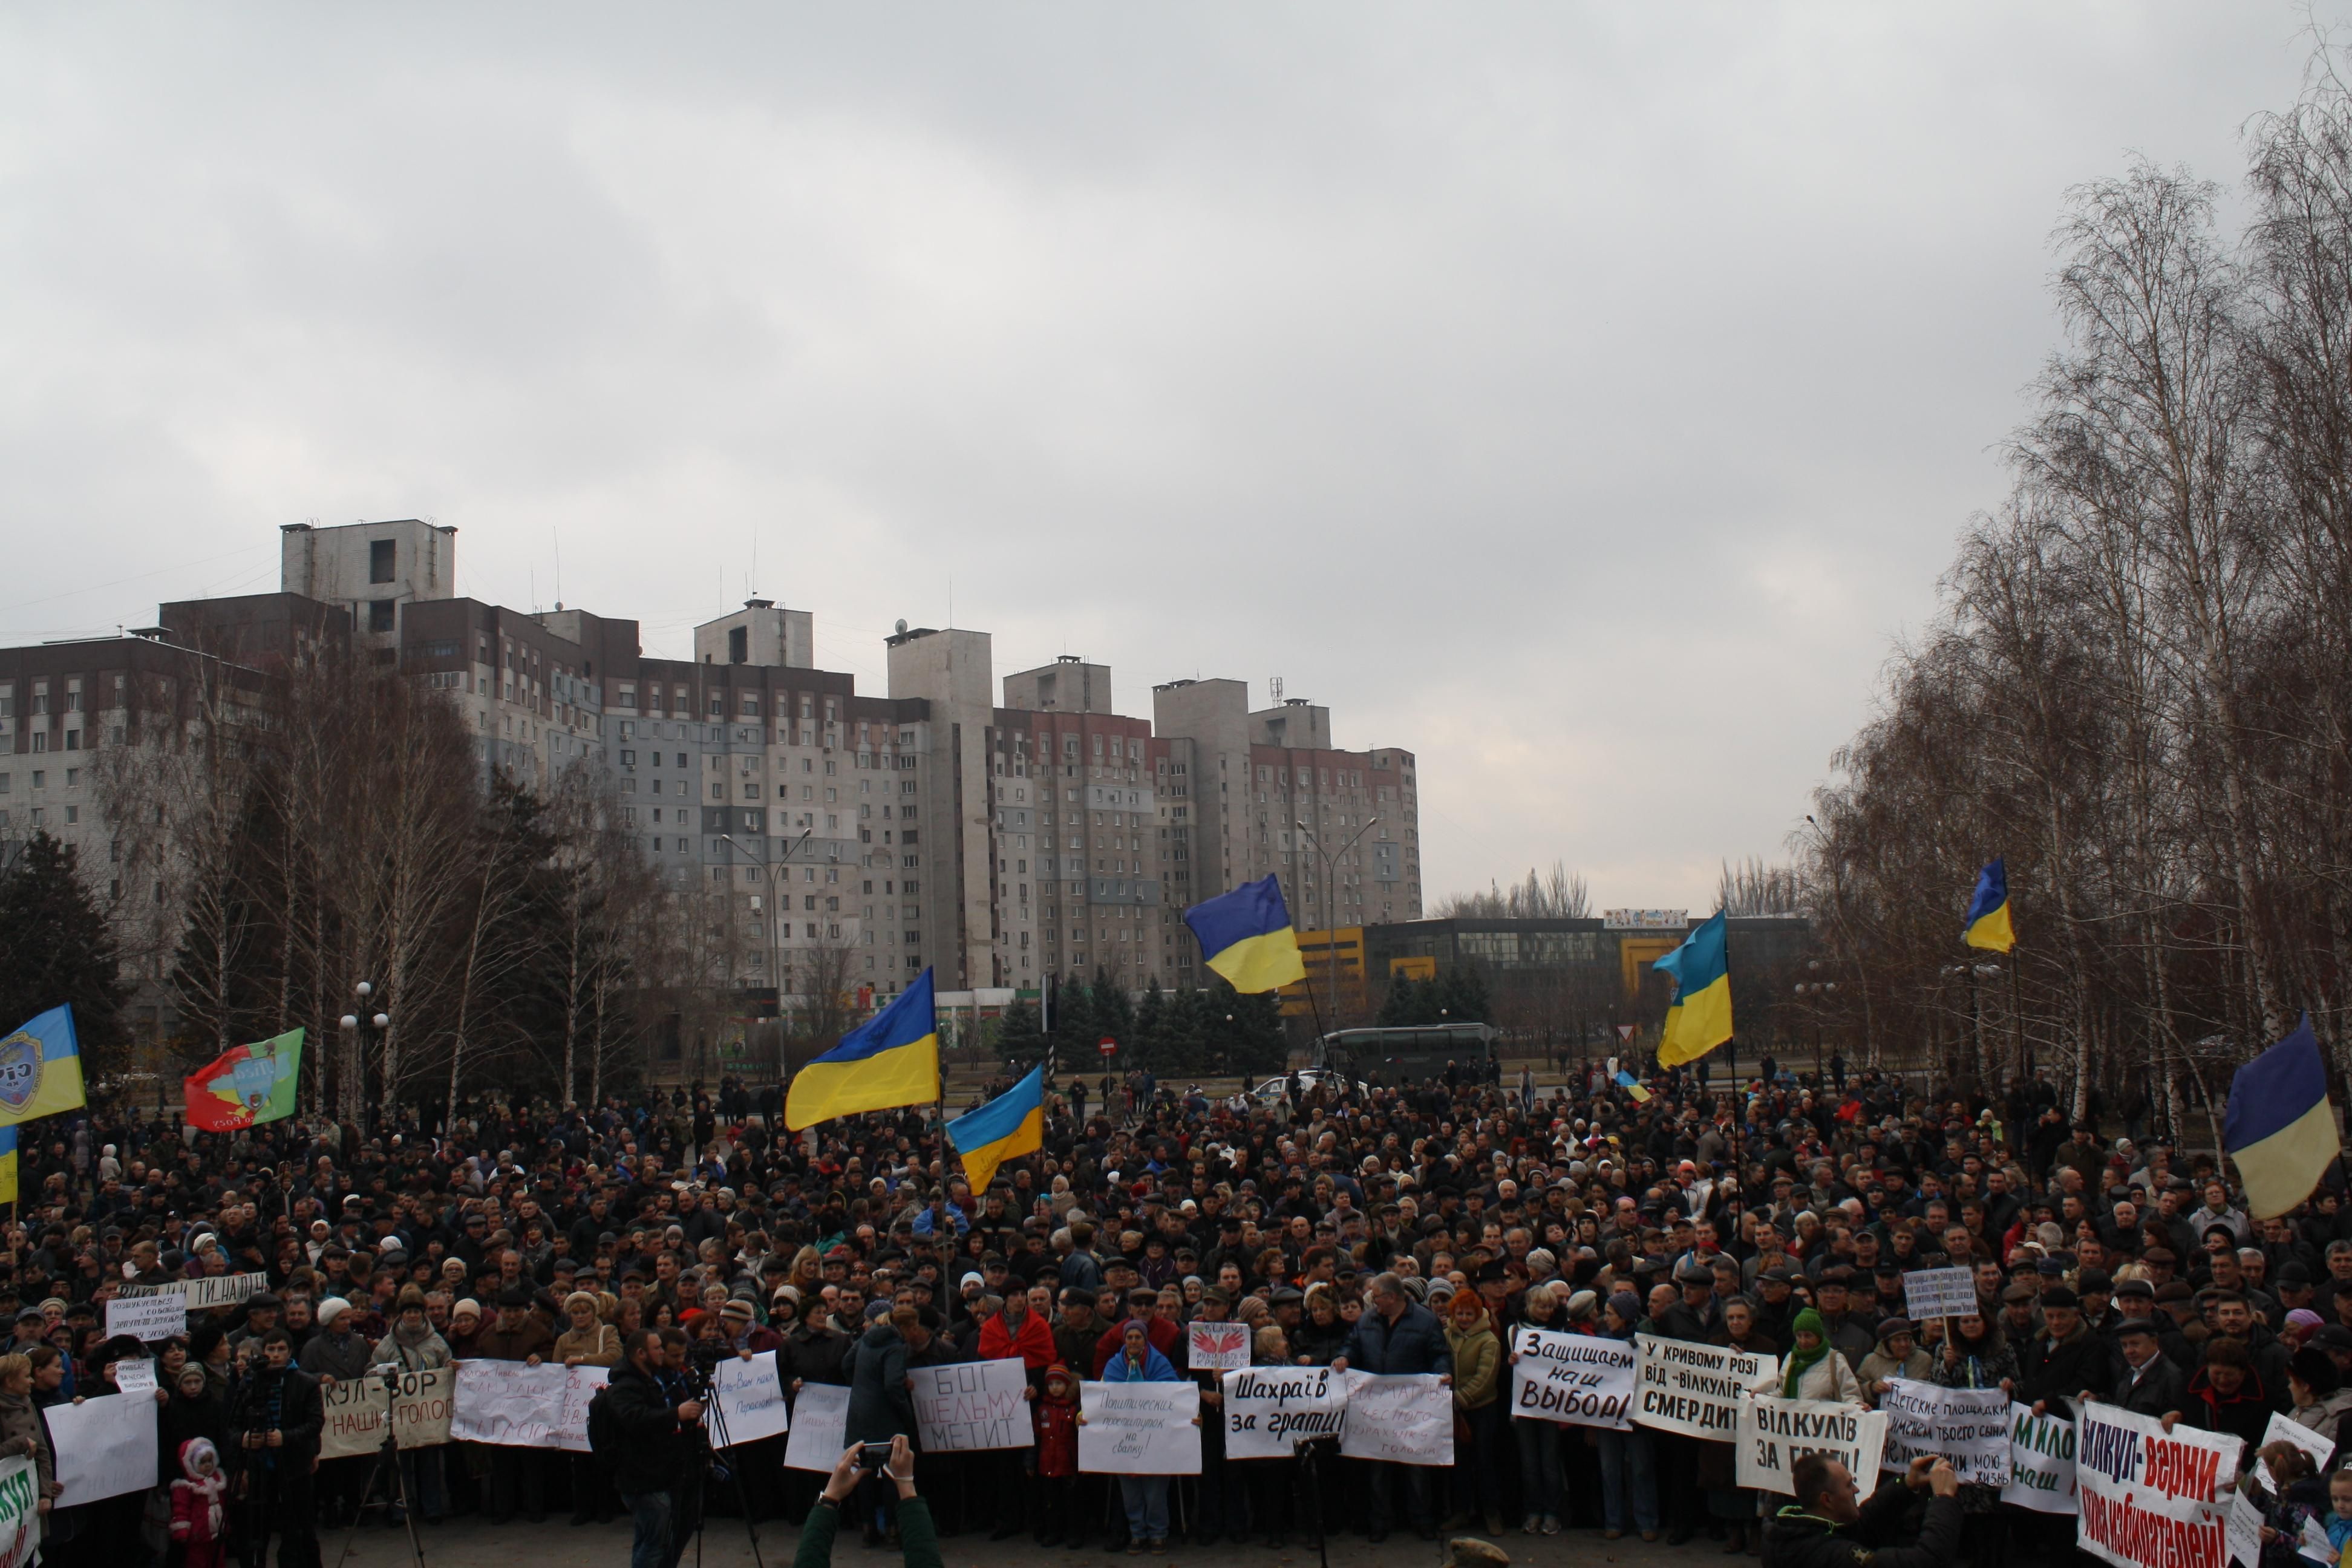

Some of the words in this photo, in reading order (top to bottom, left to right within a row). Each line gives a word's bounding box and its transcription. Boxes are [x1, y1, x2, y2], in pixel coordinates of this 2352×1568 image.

[1523, 1333, 1633, 1370] Защищаем
[1646, 1342, 1657, 1356] У
[1663, 1345, 1725, 1370] КРИВОМУ
[935, 1364, 995, 1395] БОГ
[1235, 1368, 1330, 1408] Шахраїв
[1547, 1365, 1604, 1388] наш
[917, 1389, 1022, 1423] ШЕЛЬМУ
[1100, 1390, 1176, 1411] Политических
[1520, 1380, 1632, 1426] ВЫБОР!
[1887, 1383, 1938, 1415] Детские
[930, 1418, 1015, 1450] МЕТИТ
[1102, 1416, 1166, 1432] проституток
[1125, 1431, 1137, 1441] на
[1231, 1414, 1257, 1433] за
[1757, 1438, 1780, 1471] ЗА
